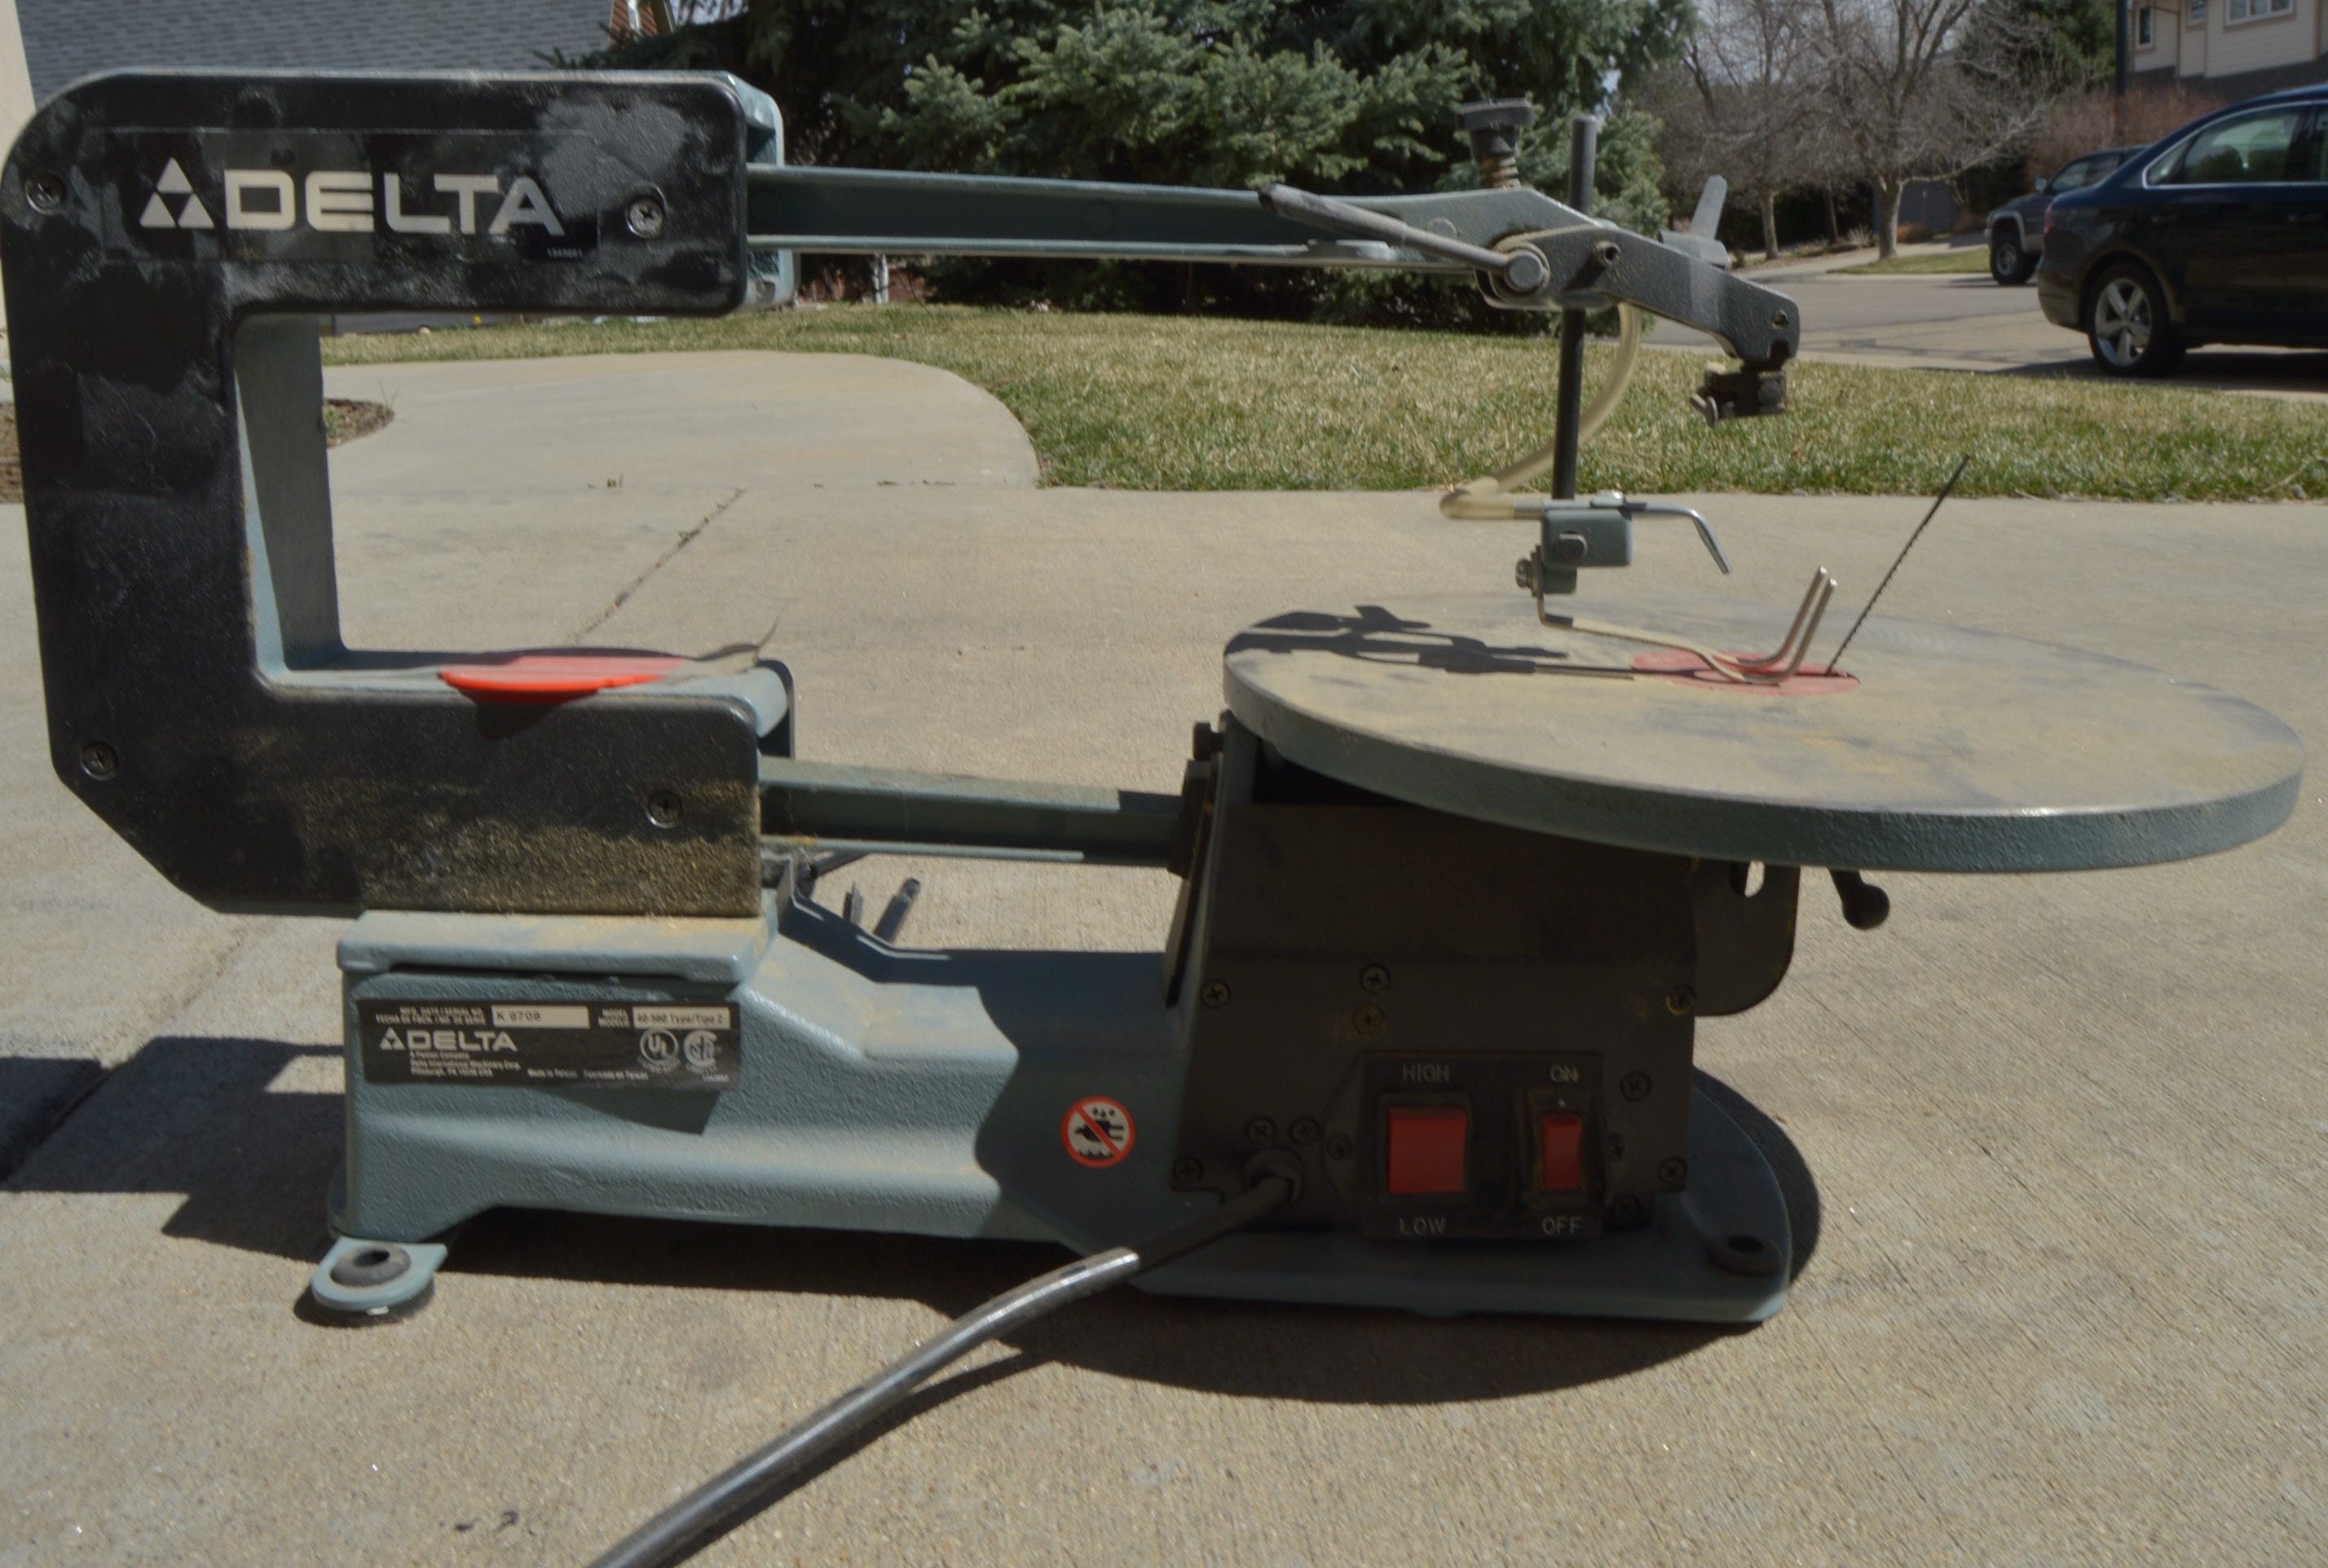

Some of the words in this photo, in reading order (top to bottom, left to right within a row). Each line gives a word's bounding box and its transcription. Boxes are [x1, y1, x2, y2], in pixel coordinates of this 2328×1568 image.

[225, 168, 564, 236] DELTA
[407, 1029, 518, 1052] DELTA
[1402, 1063, 1450, 1082] HIGH
[1550, 1064, 1579, 1083] ON
[1399, 1217, 1446, 1235] LOW
[1542, 1216, 1583, 1235] OFF
